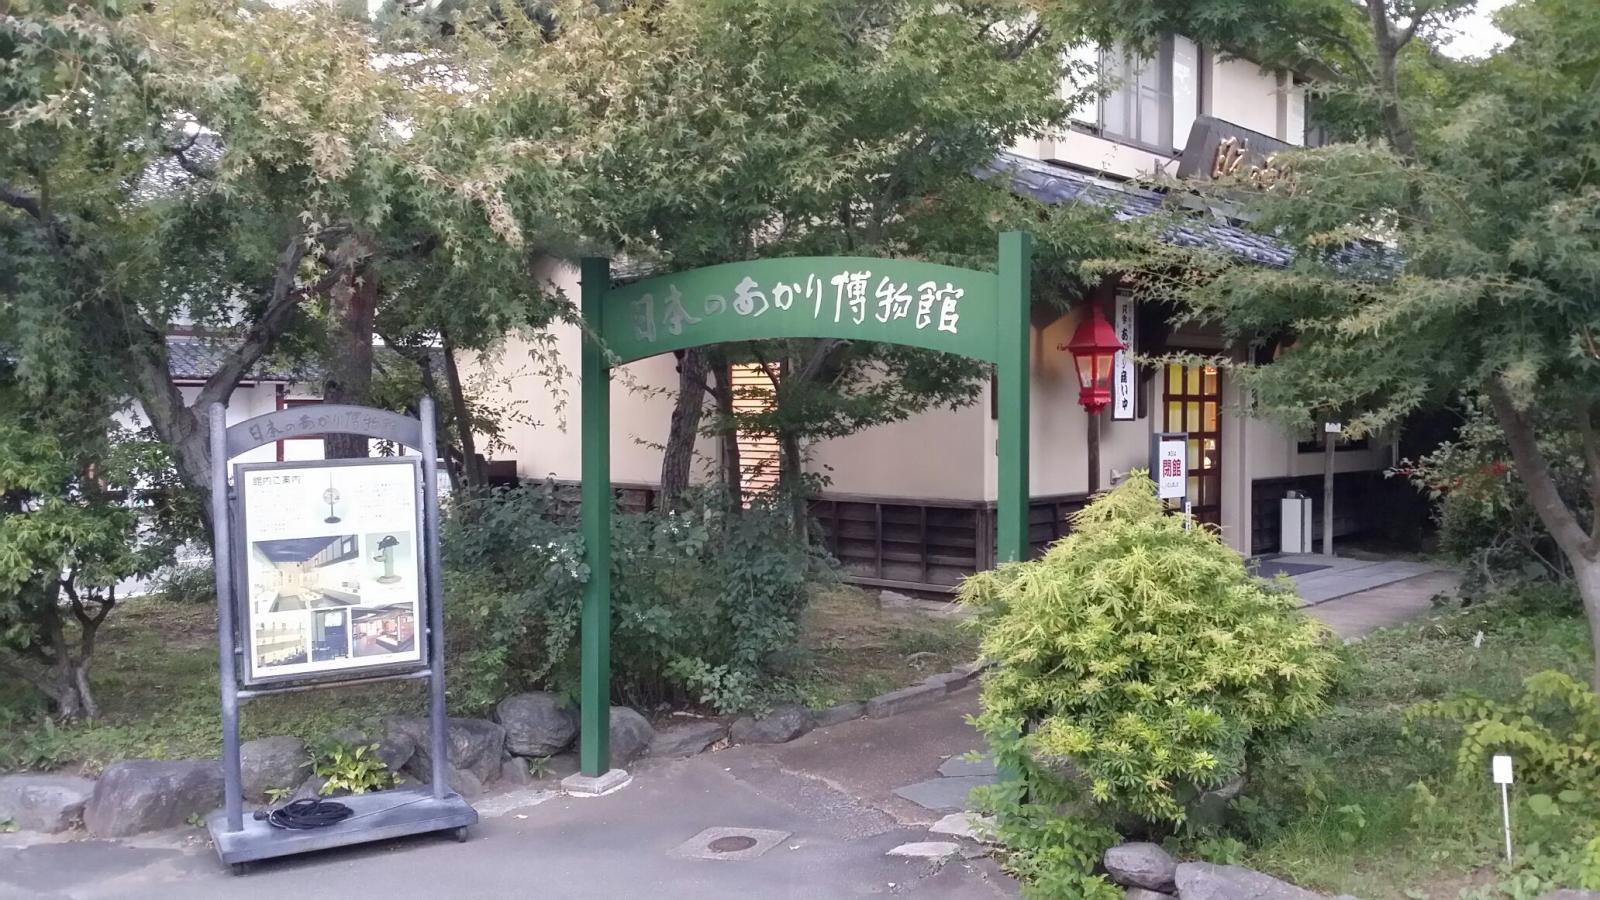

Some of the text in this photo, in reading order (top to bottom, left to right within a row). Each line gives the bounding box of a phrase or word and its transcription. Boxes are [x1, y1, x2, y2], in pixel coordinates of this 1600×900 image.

[630, 270, 964, 342] 日本のあかり博物館
[1162, 458, 1182, 478] 閉館
